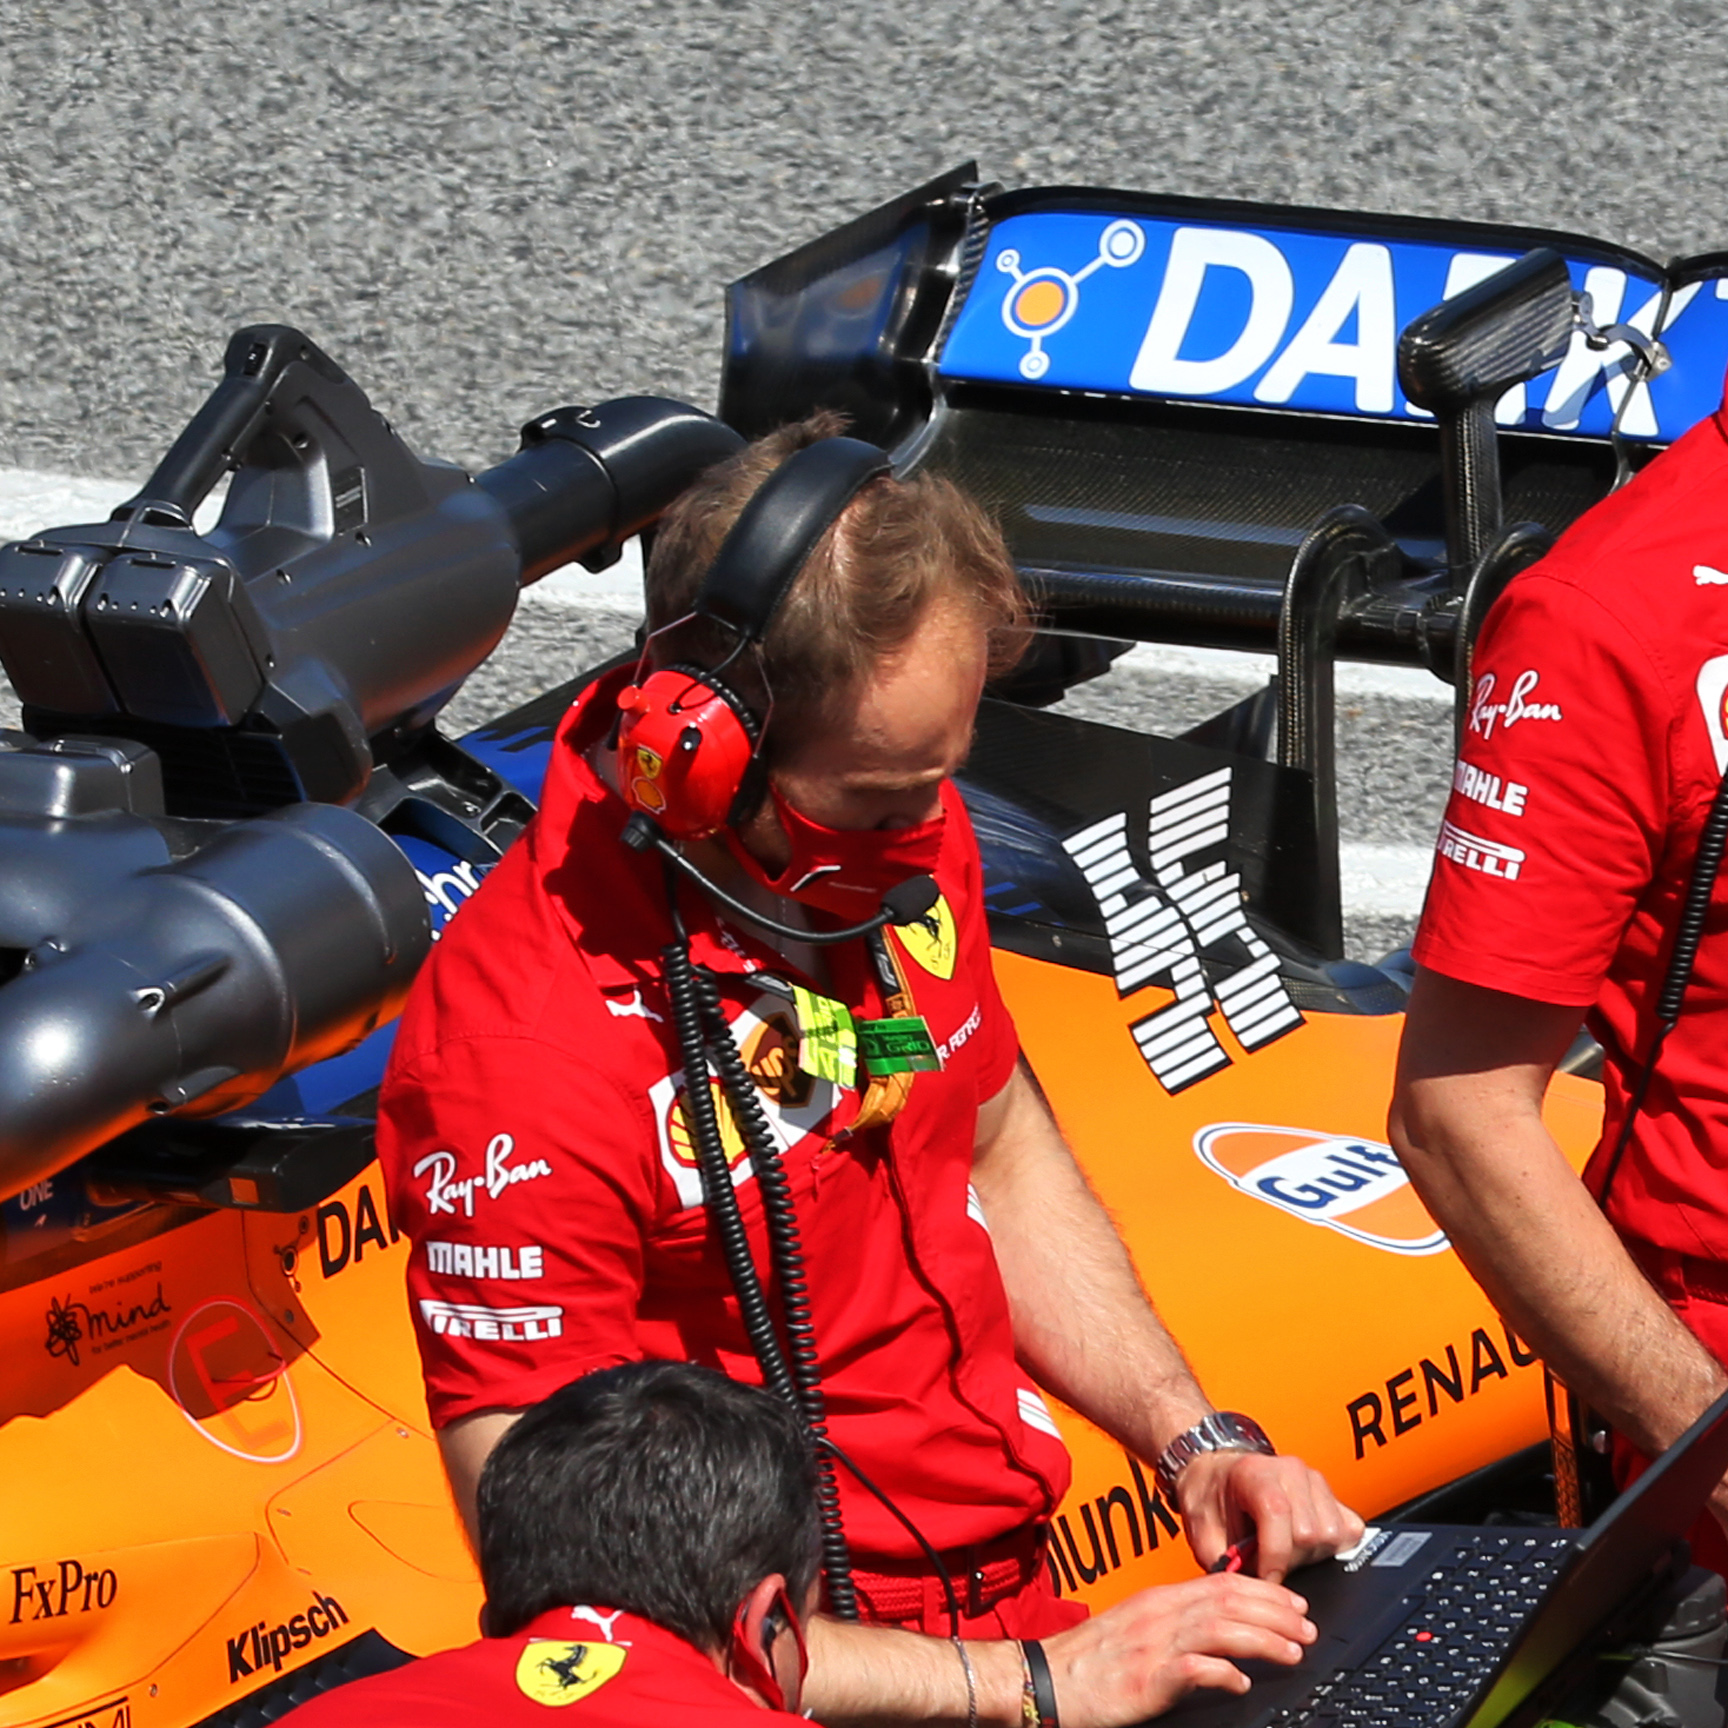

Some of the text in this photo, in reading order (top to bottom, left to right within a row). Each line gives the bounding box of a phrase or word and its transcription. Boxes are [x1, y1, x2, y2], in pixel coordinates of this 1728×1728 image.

[1257, 1139, 1405, 1212] Gulf
[426, 1240, 544, 1280] MAHLE
[89, 1281, 173, 1341] mind
[9, 1559, 118, 1626] FxPro
[226, 1590, 351, 1685] Klipsch
